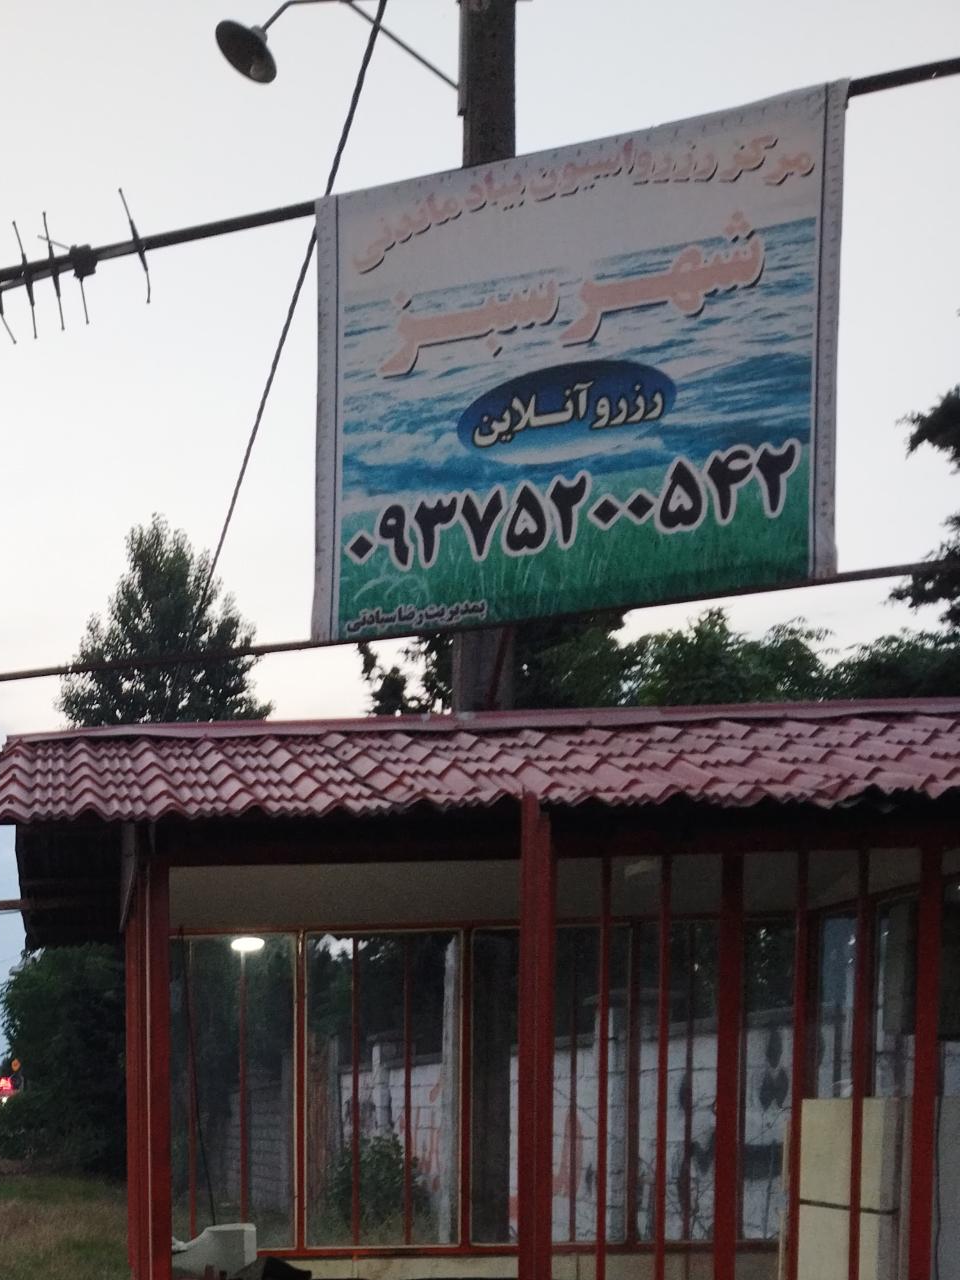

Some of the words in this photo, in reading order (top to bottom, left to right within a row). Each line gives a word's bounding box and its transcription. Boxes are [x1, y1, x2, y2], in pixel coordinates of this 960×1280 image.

[378, 276, 559, 378] سبز
[560, 209, 765, 346] شهر
[473, 380, 594, 447] آنلاین
[590, 384, 664, 430] رزرو
[347, 440, 799, 568] ۰۹۳۷۵۲۰۰۵۴۲
